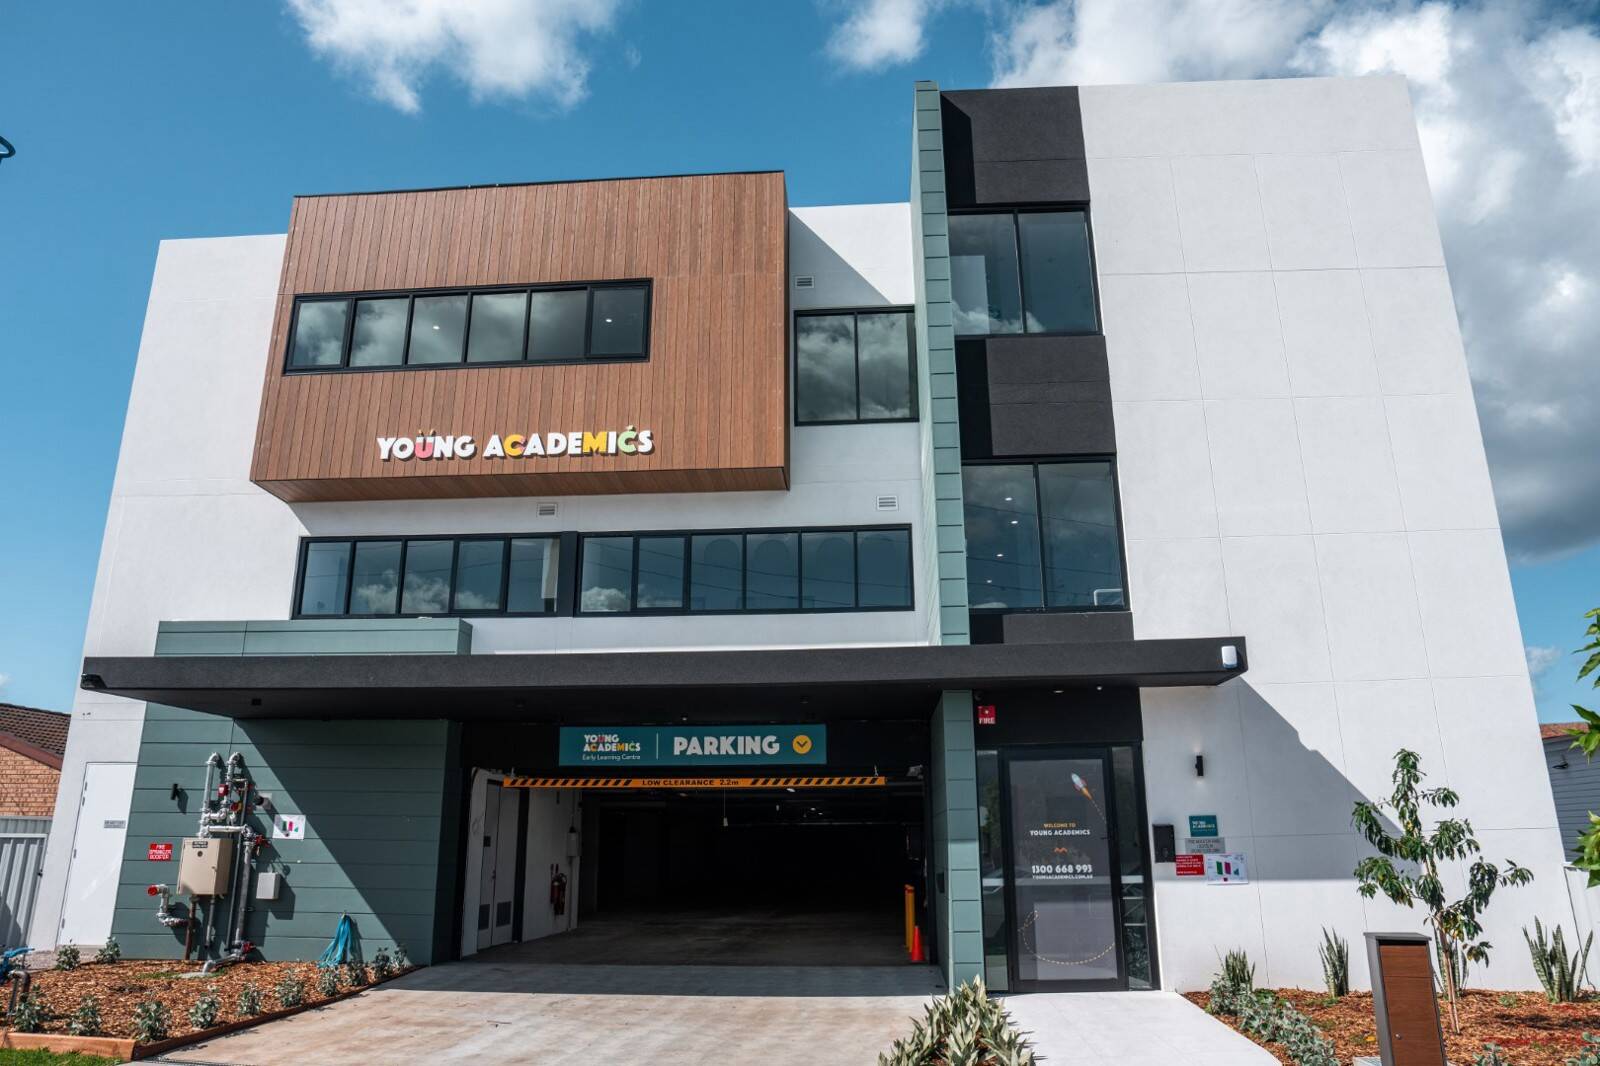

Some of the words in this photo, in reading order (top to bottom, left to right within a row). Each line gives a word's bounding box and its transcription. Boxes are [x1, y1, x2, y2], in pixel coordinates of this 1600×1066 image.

[376, 430, 476, 460] YOUNG
[483, 426, 653, 458] ACADEMICS
[584, 734, 620, 743] YOUNG
[583, 742, 641, 752] ACADEMICS
[673, 735, 780, 756] PARKING
[1031, 864, 1053, 874] 1300
[1055, 864, 1074, 873] 668
[1075, 864, 1093, 873] 993
